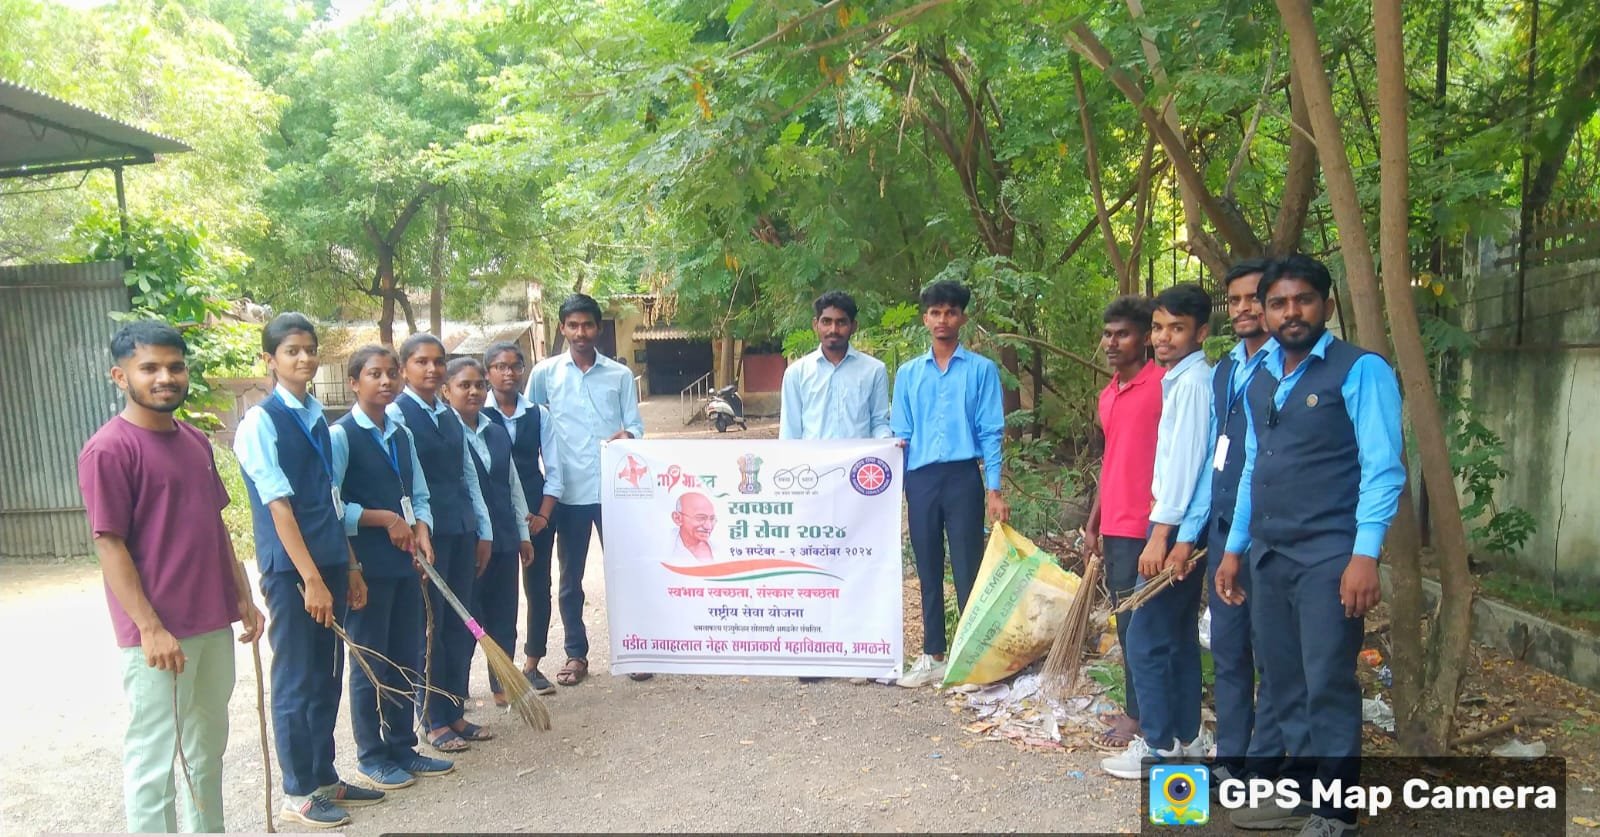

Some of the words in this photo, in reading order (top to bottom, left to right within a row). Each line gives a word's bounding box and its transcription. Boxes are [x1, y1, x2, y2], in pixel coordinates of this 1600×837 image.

[728, 501, 794, 515] स्वच्छता
[728, 519, 749, 540] ही
[754, 519, 790, 538] सेवा
[797, 525, 847, 538] २०२४
[730, 547, 743, 557] १७
[790, 547, 796, 557] २
[845, 547, 873, 557] २०२४
[667, 586, 704, 598] स्वभाव
[708, 586, 753, 599] स्वच्छता,
[756, 584, 794, 598] संस्कार
[797, 587, 840, 599] स्वच्छता
[708, 604, 738, 620] राष्ट्रीय
[742, 603, 764, 618] सेवा
[768, 604, 804, 619] योजना
[622, 634, 648, 651] पंडीत
[651, 638, 702, 653] जवाहरलाल
[732, 636, 781, 654] समाजकार्य
[852, 638, 891, 655] अमळनेर
